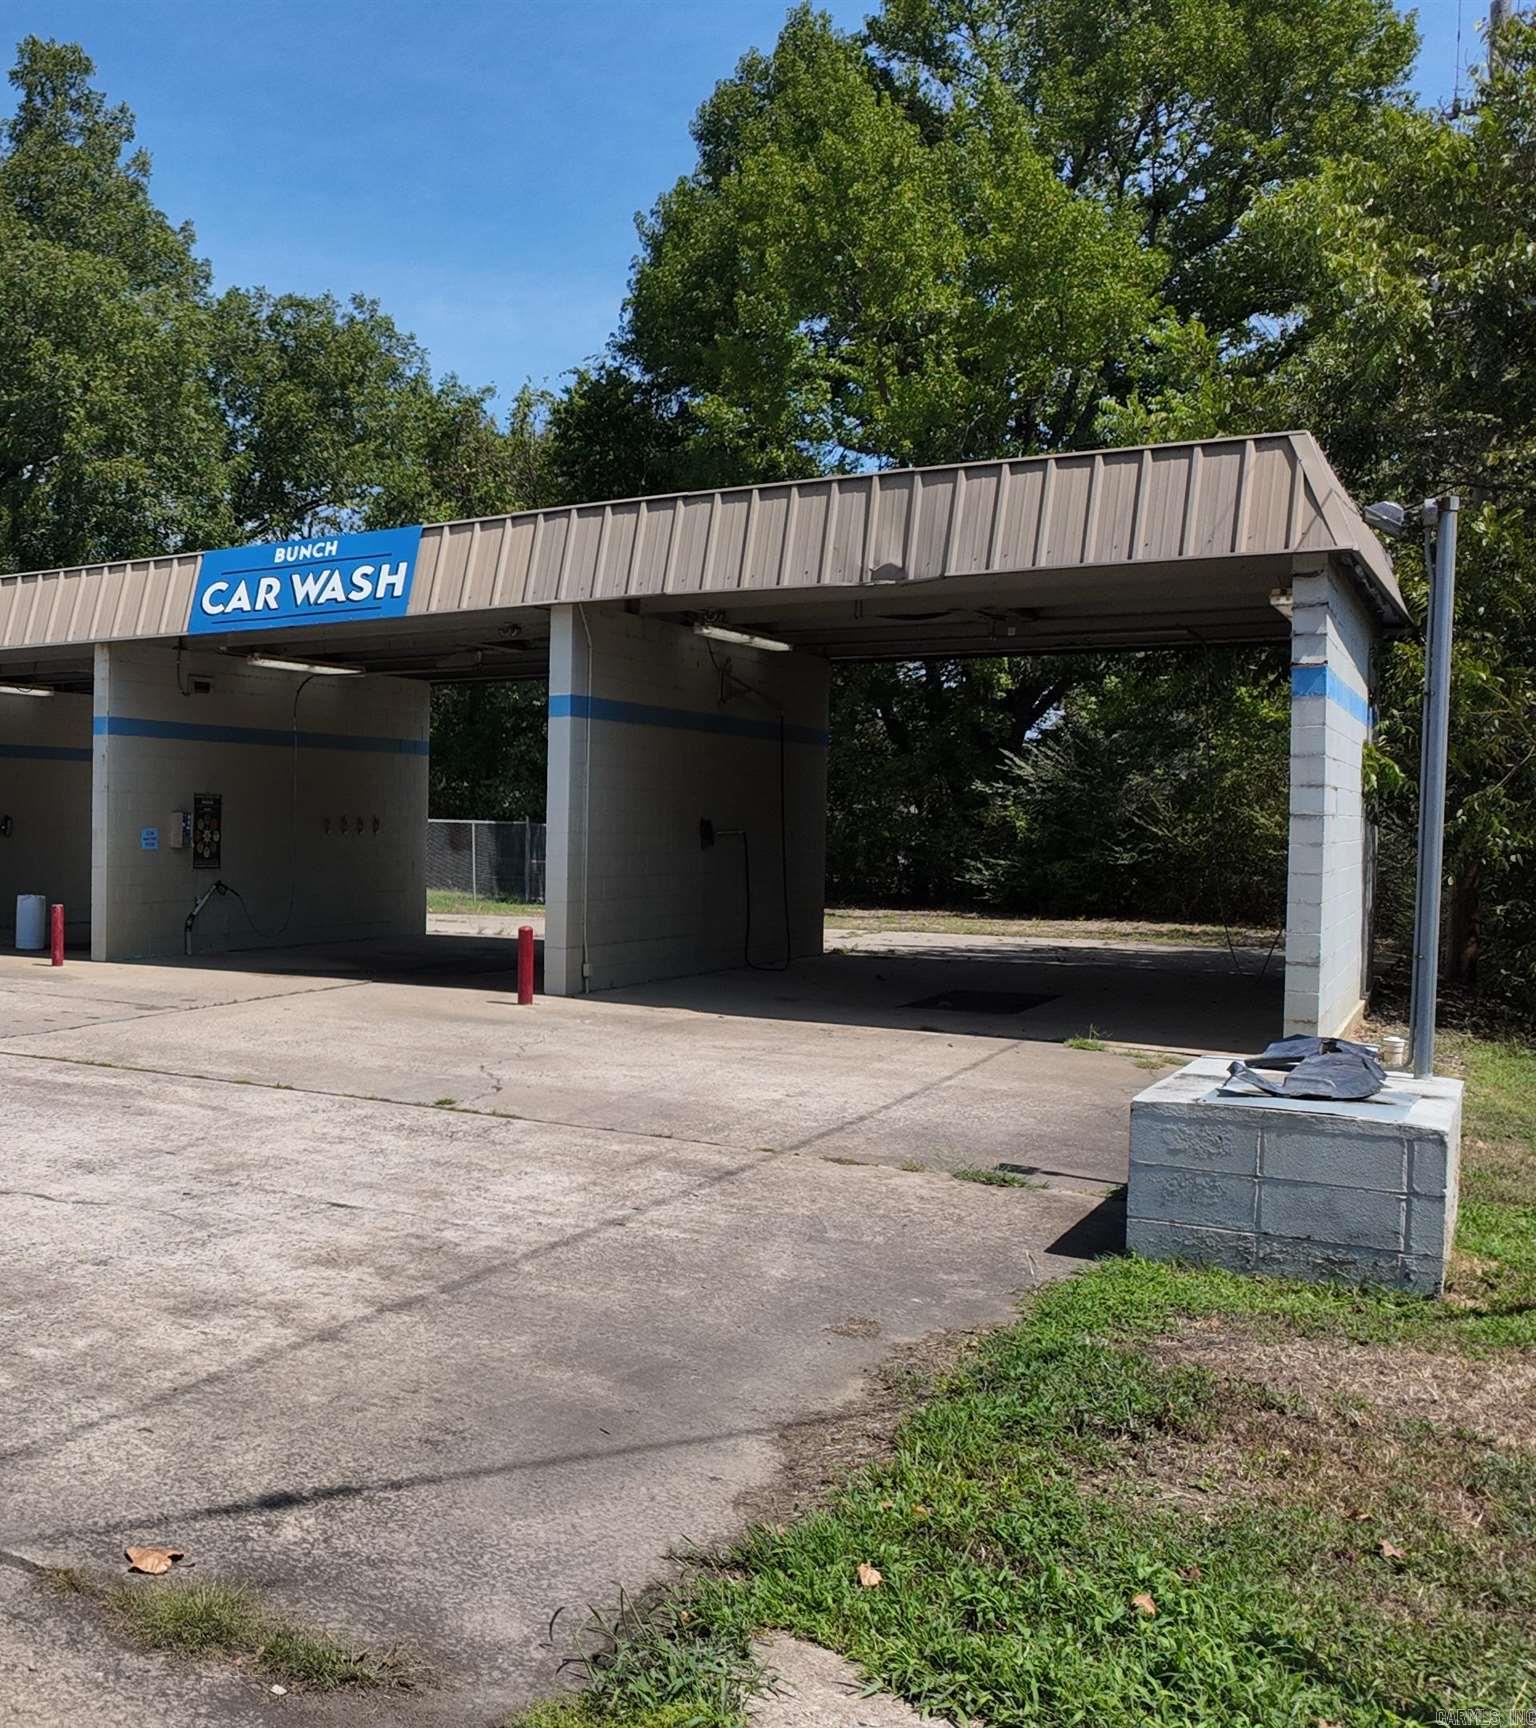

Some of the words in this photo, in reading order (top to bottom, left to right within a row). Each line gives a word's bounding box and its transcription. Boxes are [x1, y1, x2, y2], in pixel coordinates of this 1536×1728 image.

[273, 540, 338, 563] BUNCH
[201, 577, 281, 615] CAR
[291, 561, 408, 608] WASH
